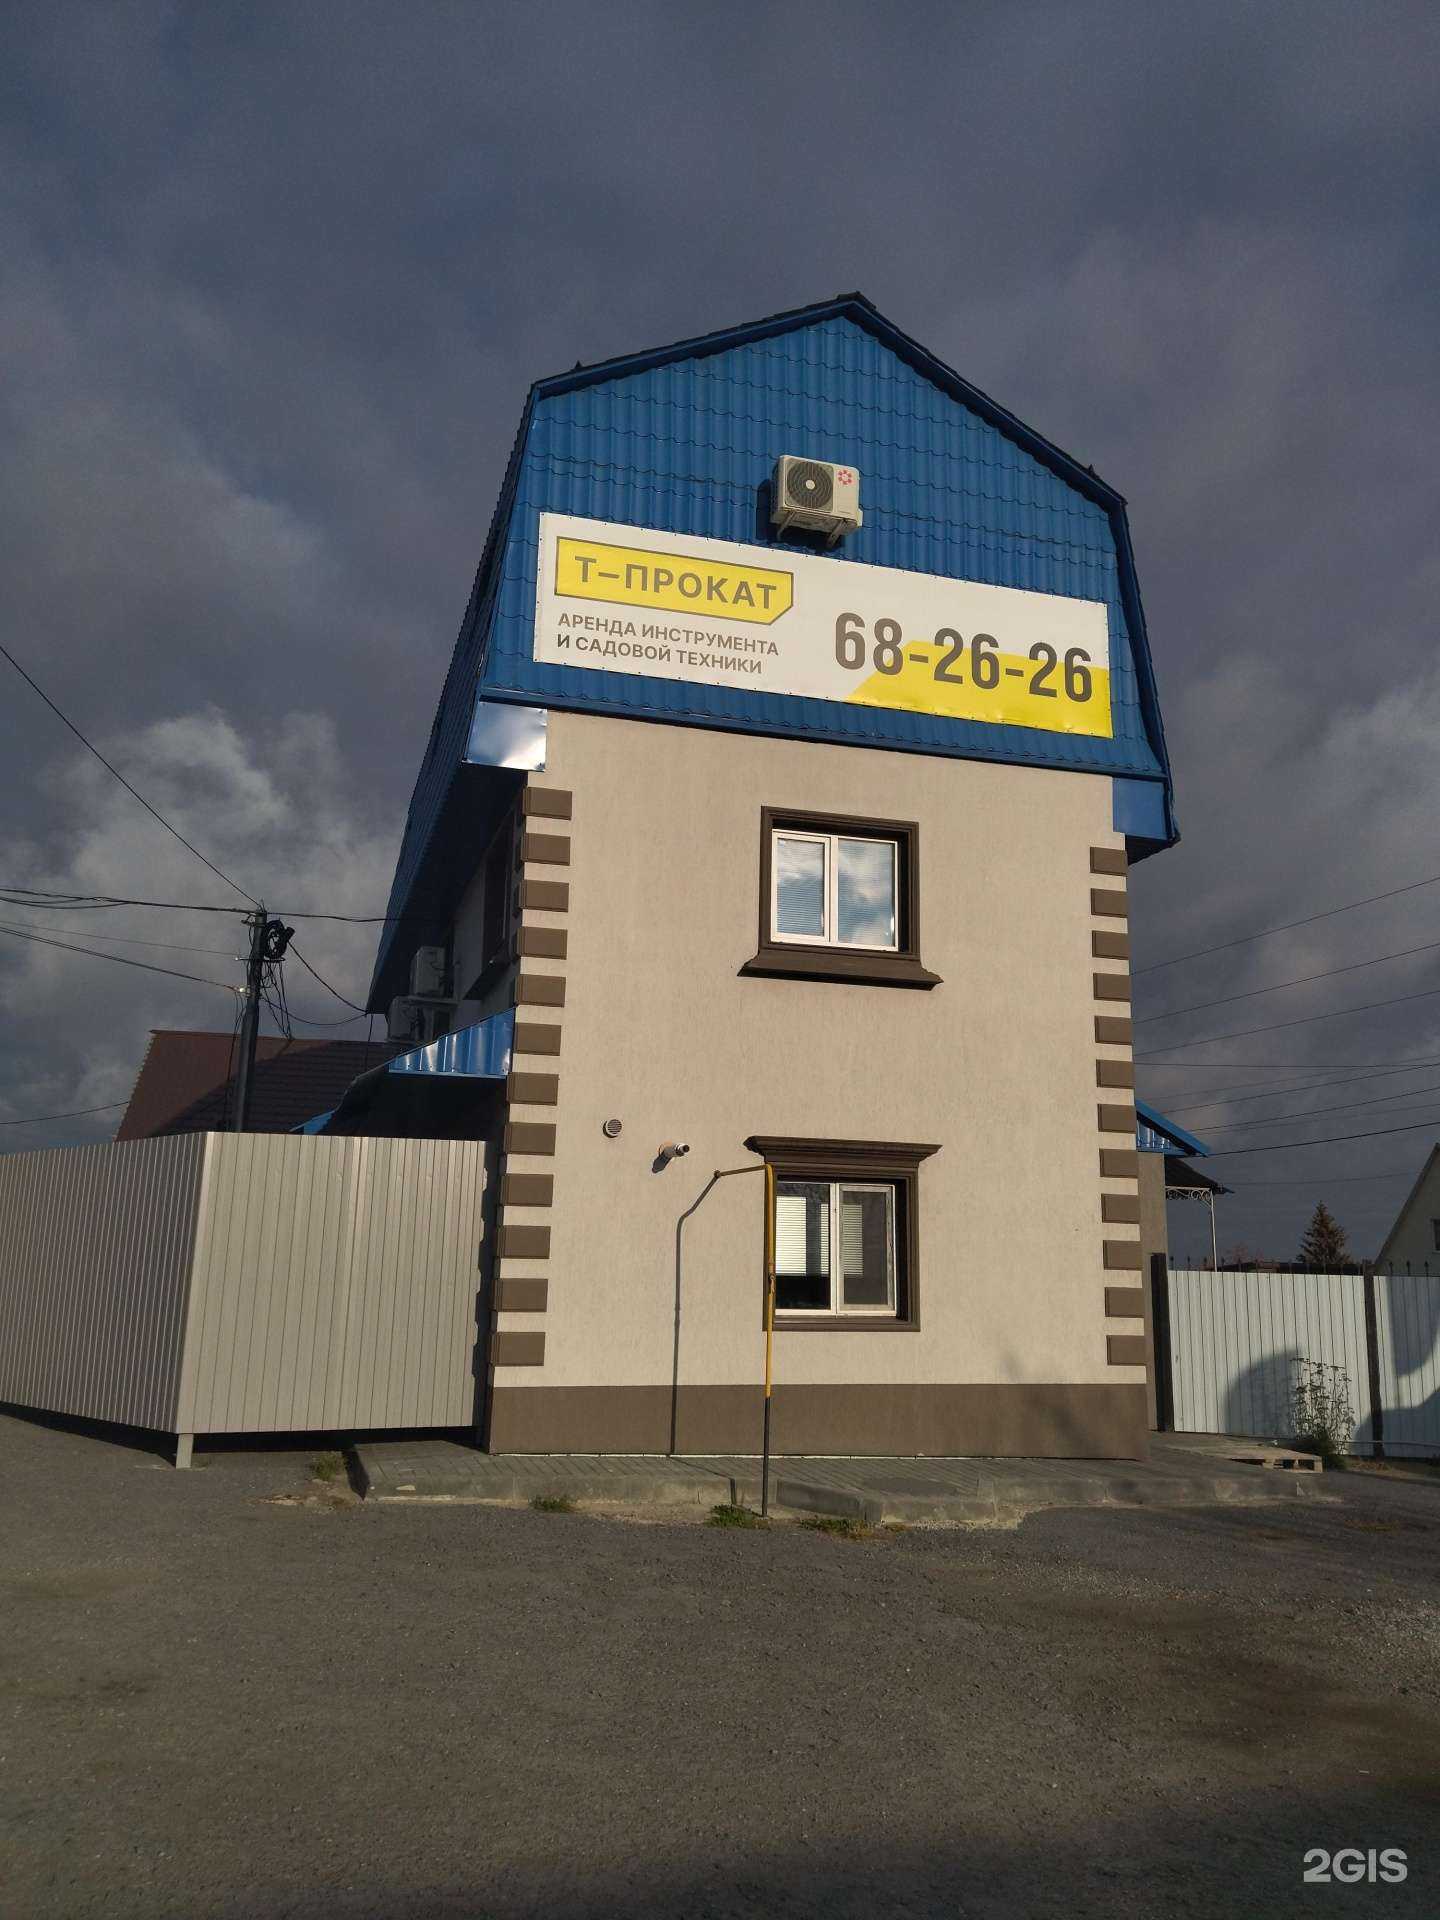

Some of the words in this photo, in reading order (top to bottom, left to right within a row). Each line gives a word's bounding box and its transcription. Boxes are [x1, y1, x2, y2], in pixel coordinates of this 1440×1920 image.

[557, 633, 570, 649] И
[575, 636, 671, 662] САДОВОЙ
[676, 649, 762, 674] ТЕХНИКИ
[558, 612, 637, 638] АРЕНДА
[642, 624, 779, 656] ИНСТРУМЕНТА
[835, 612, 1093, 703] 68-26-26
